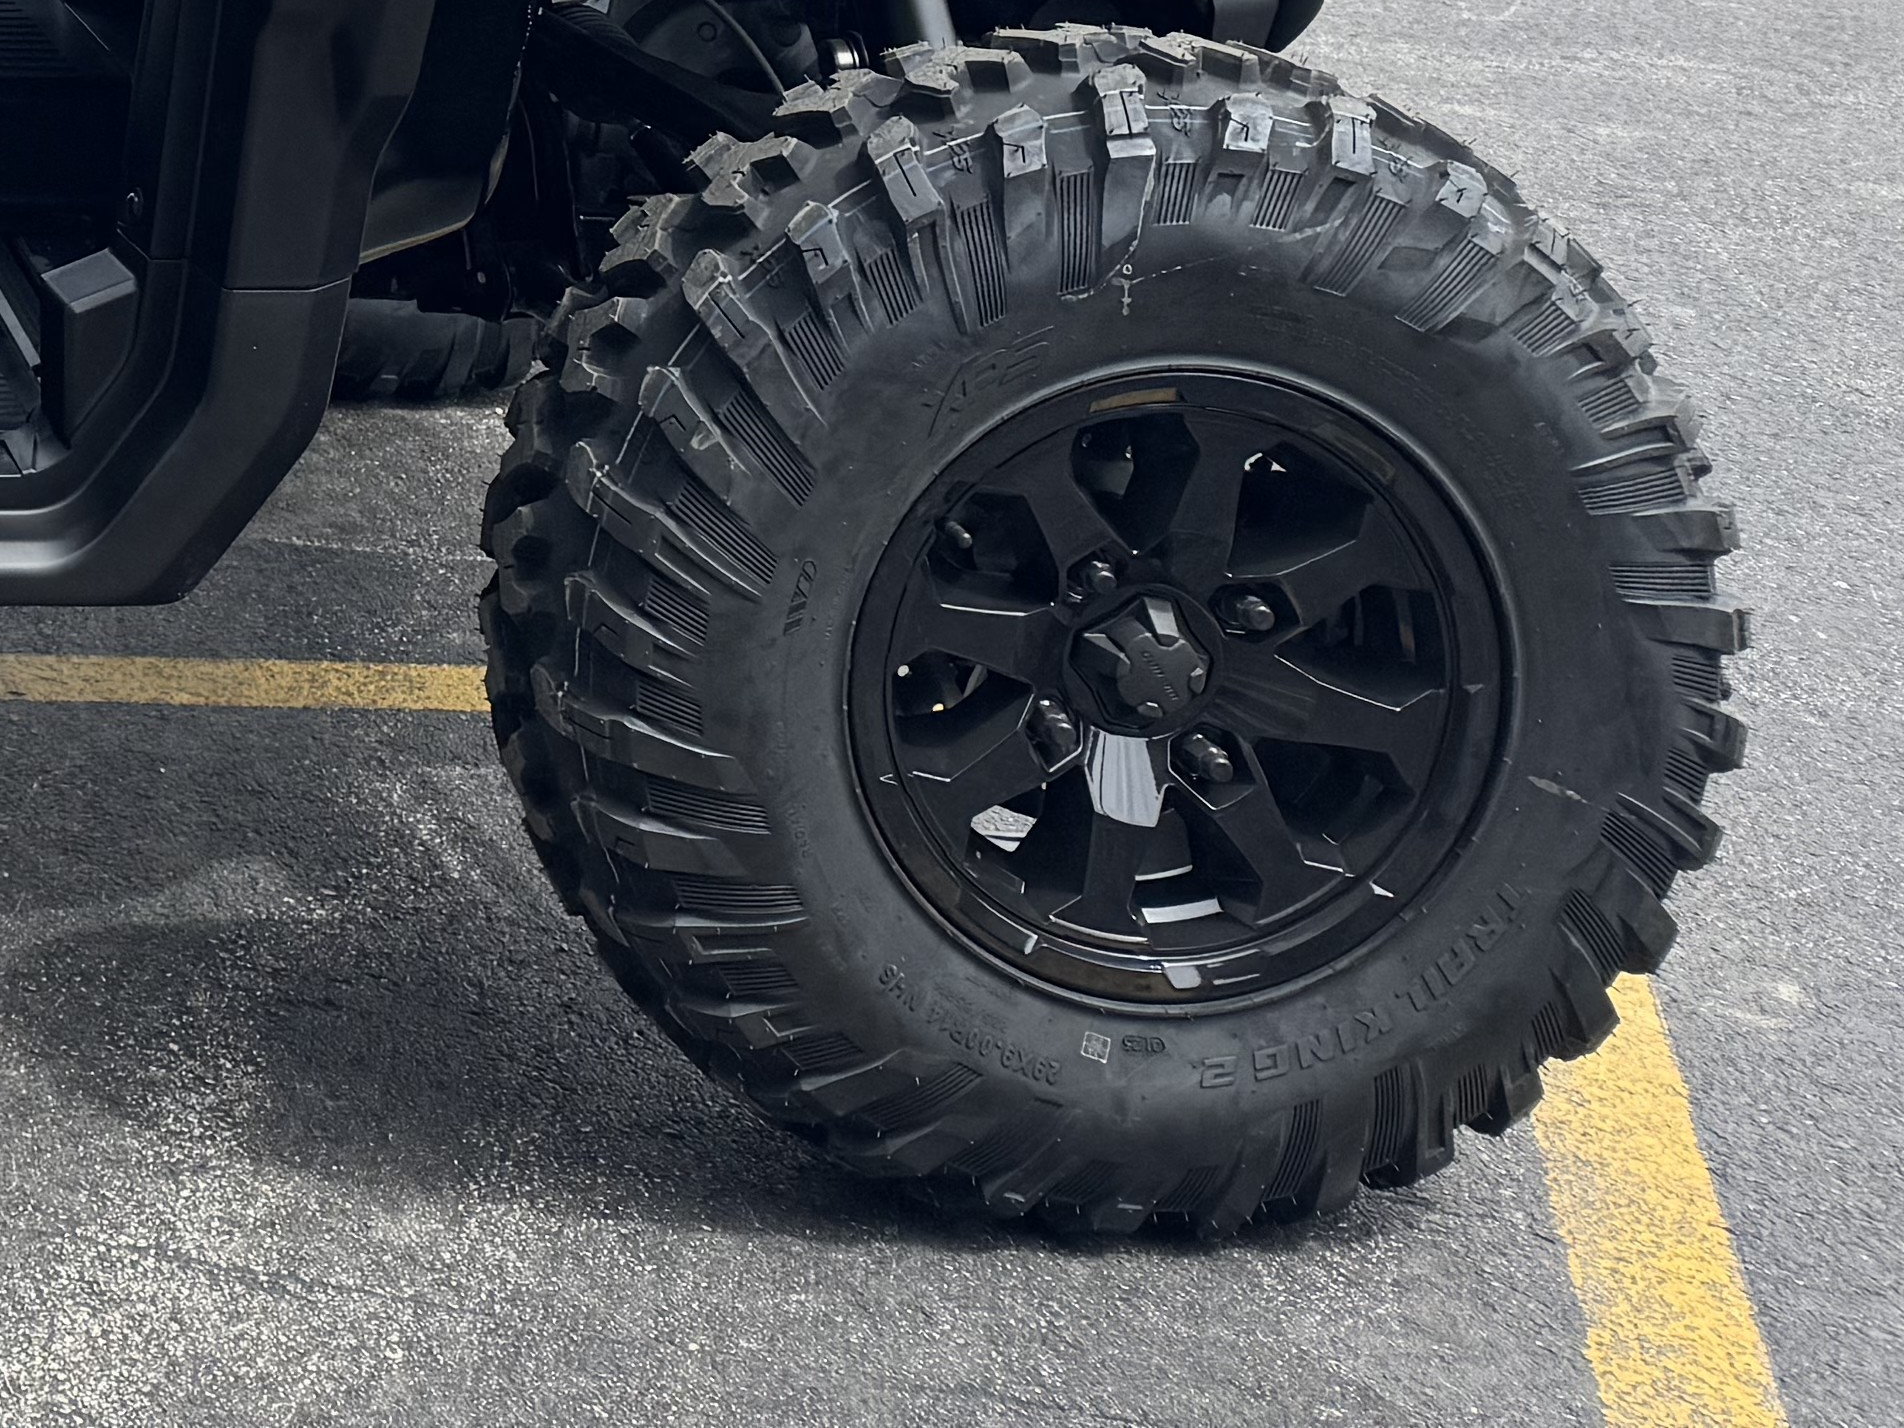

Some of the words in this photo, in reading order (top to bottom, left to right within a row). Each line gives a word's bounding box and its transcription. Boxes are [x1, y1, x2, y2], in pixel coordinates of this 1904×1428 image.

[1402, 878, 1530, 1016] TRAIL
[1196, 1053, 1243, 1090] 2
[1250, 1003, 1397, 1084] KING
